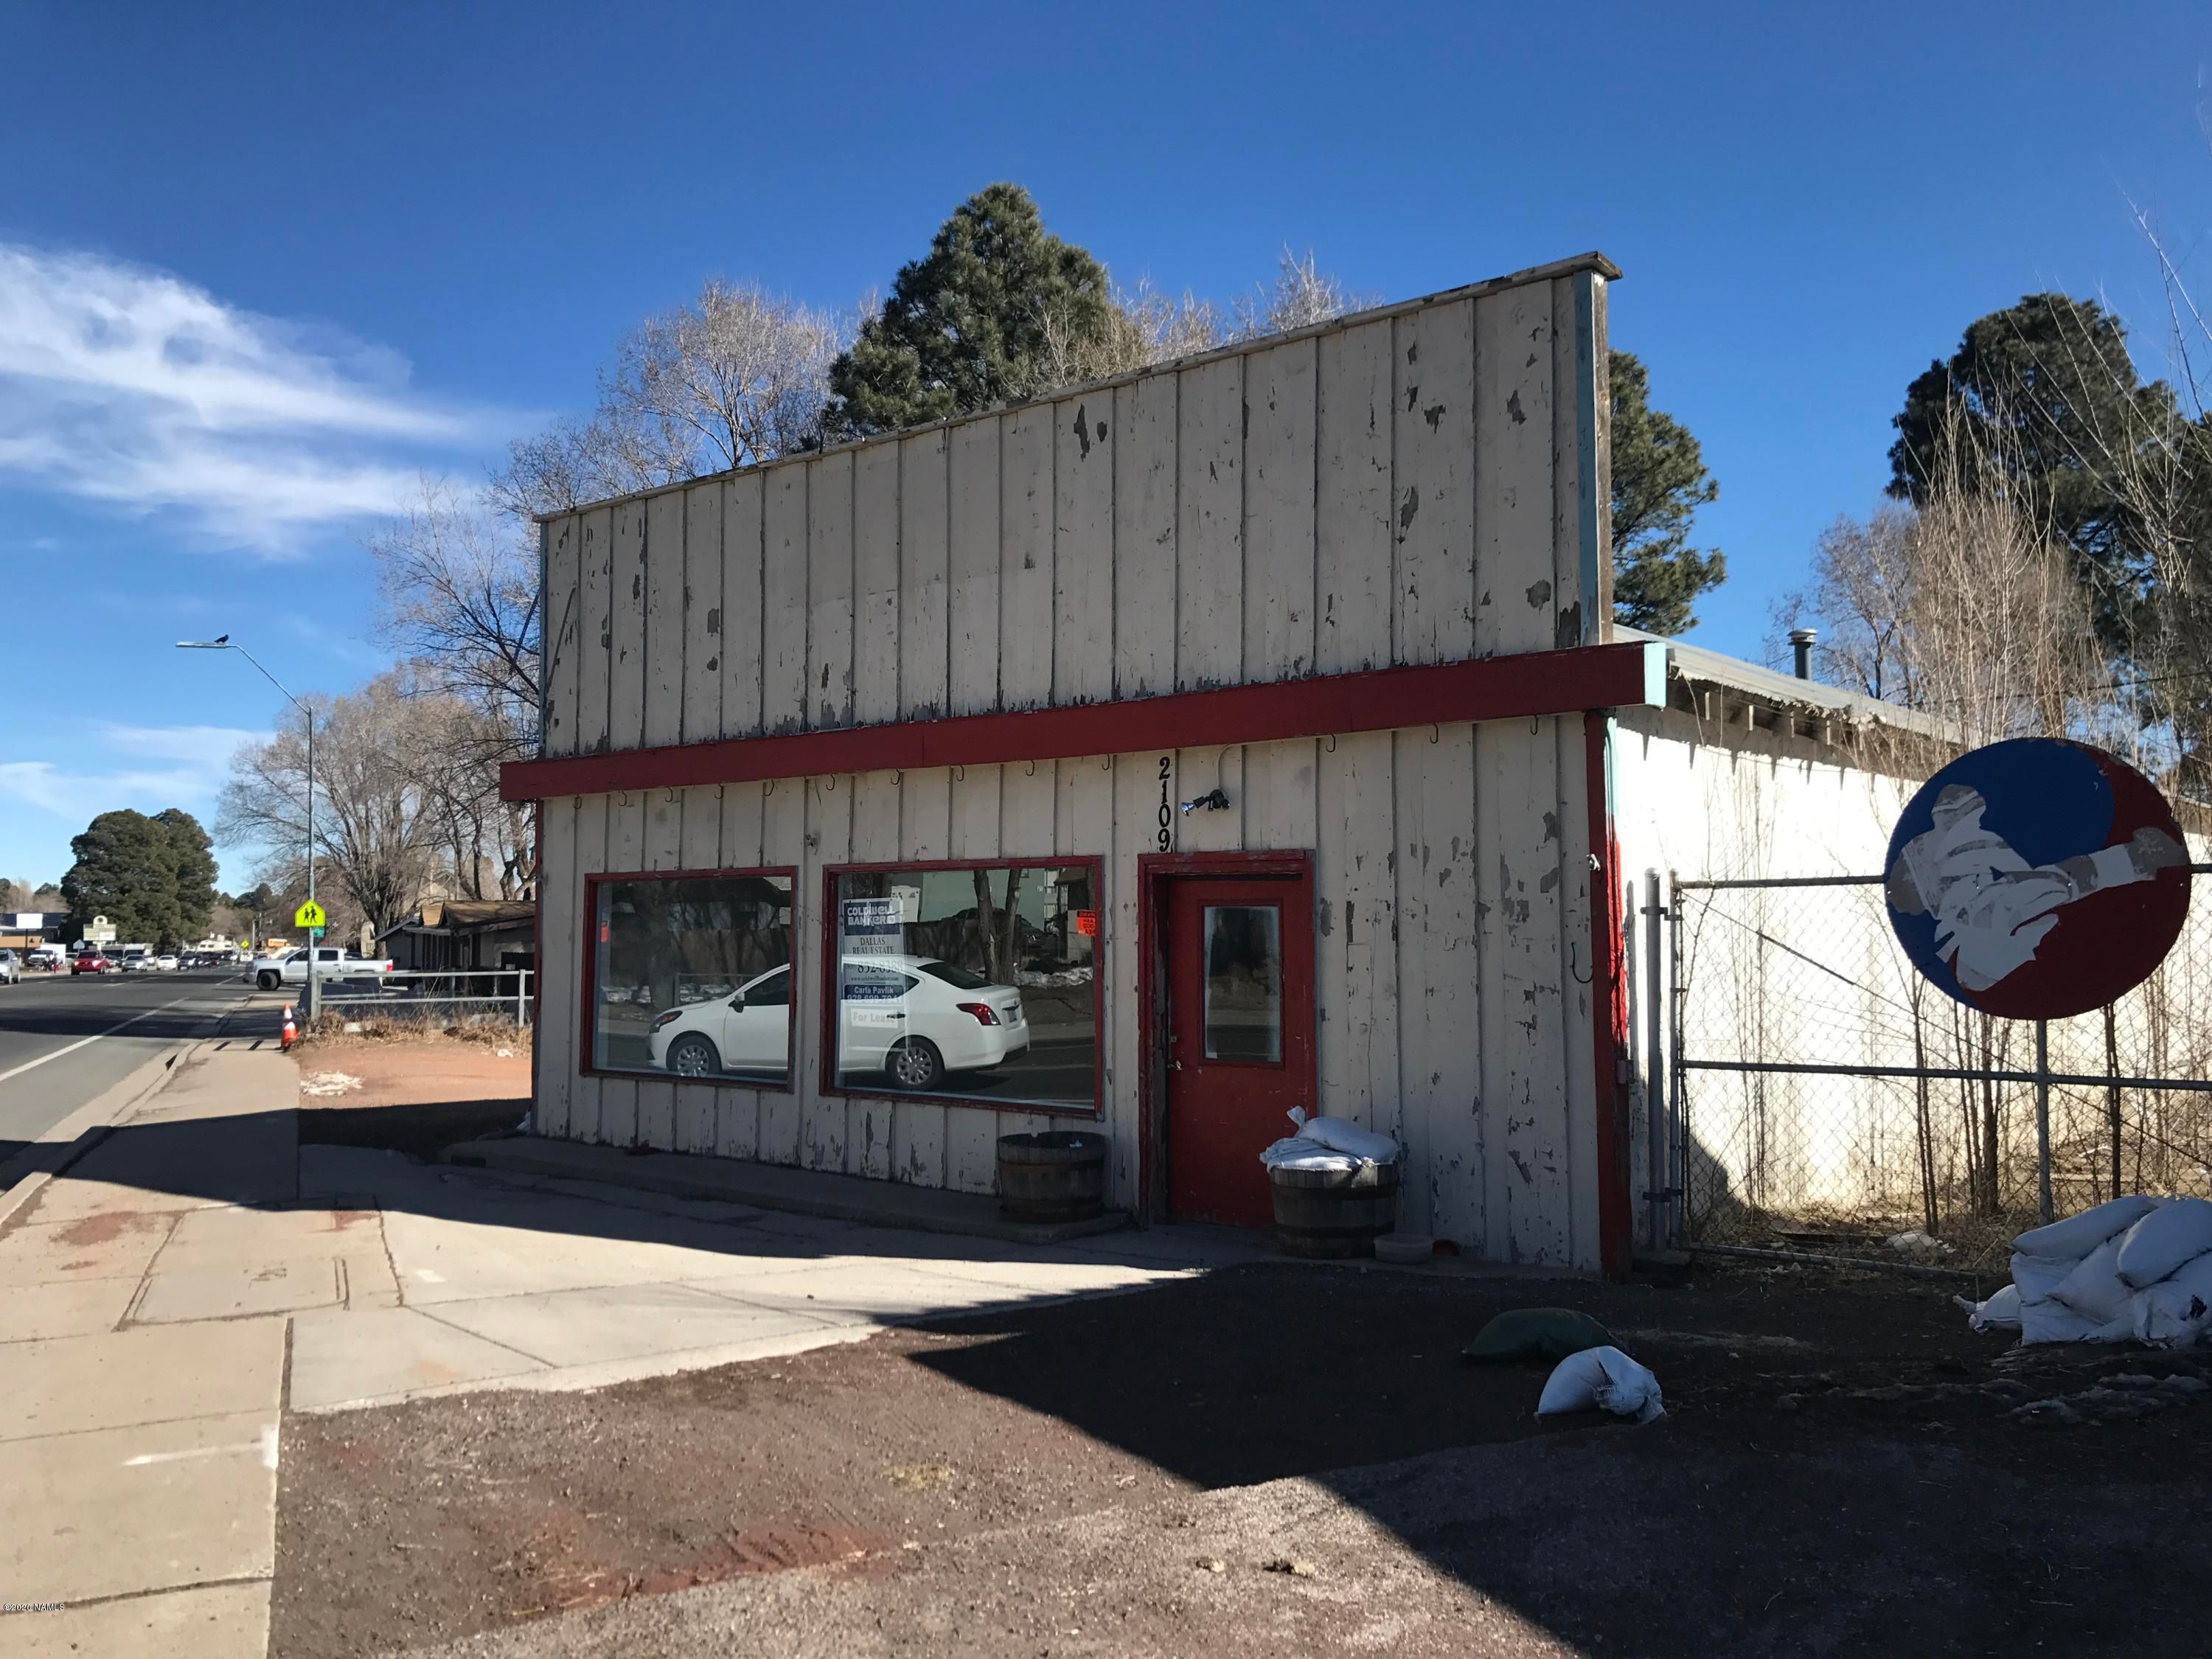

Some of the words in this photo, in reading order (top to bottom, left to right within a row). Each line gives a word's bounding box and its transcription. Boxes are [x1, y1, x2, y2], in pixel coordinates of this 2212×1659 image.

[1158, 757, 1171, 852] 2109
[848, 915, 886, 927] BANKER
[860, 936, 886, 945] DALLAS
[852, 946, 868, 955] REAL
[871, 946, 894, 954] ESTATE
[854, 986, 872, 994] Carla
[873, 986, 894, 994] Pavlik
[853, 1012, 868, 1020] For
